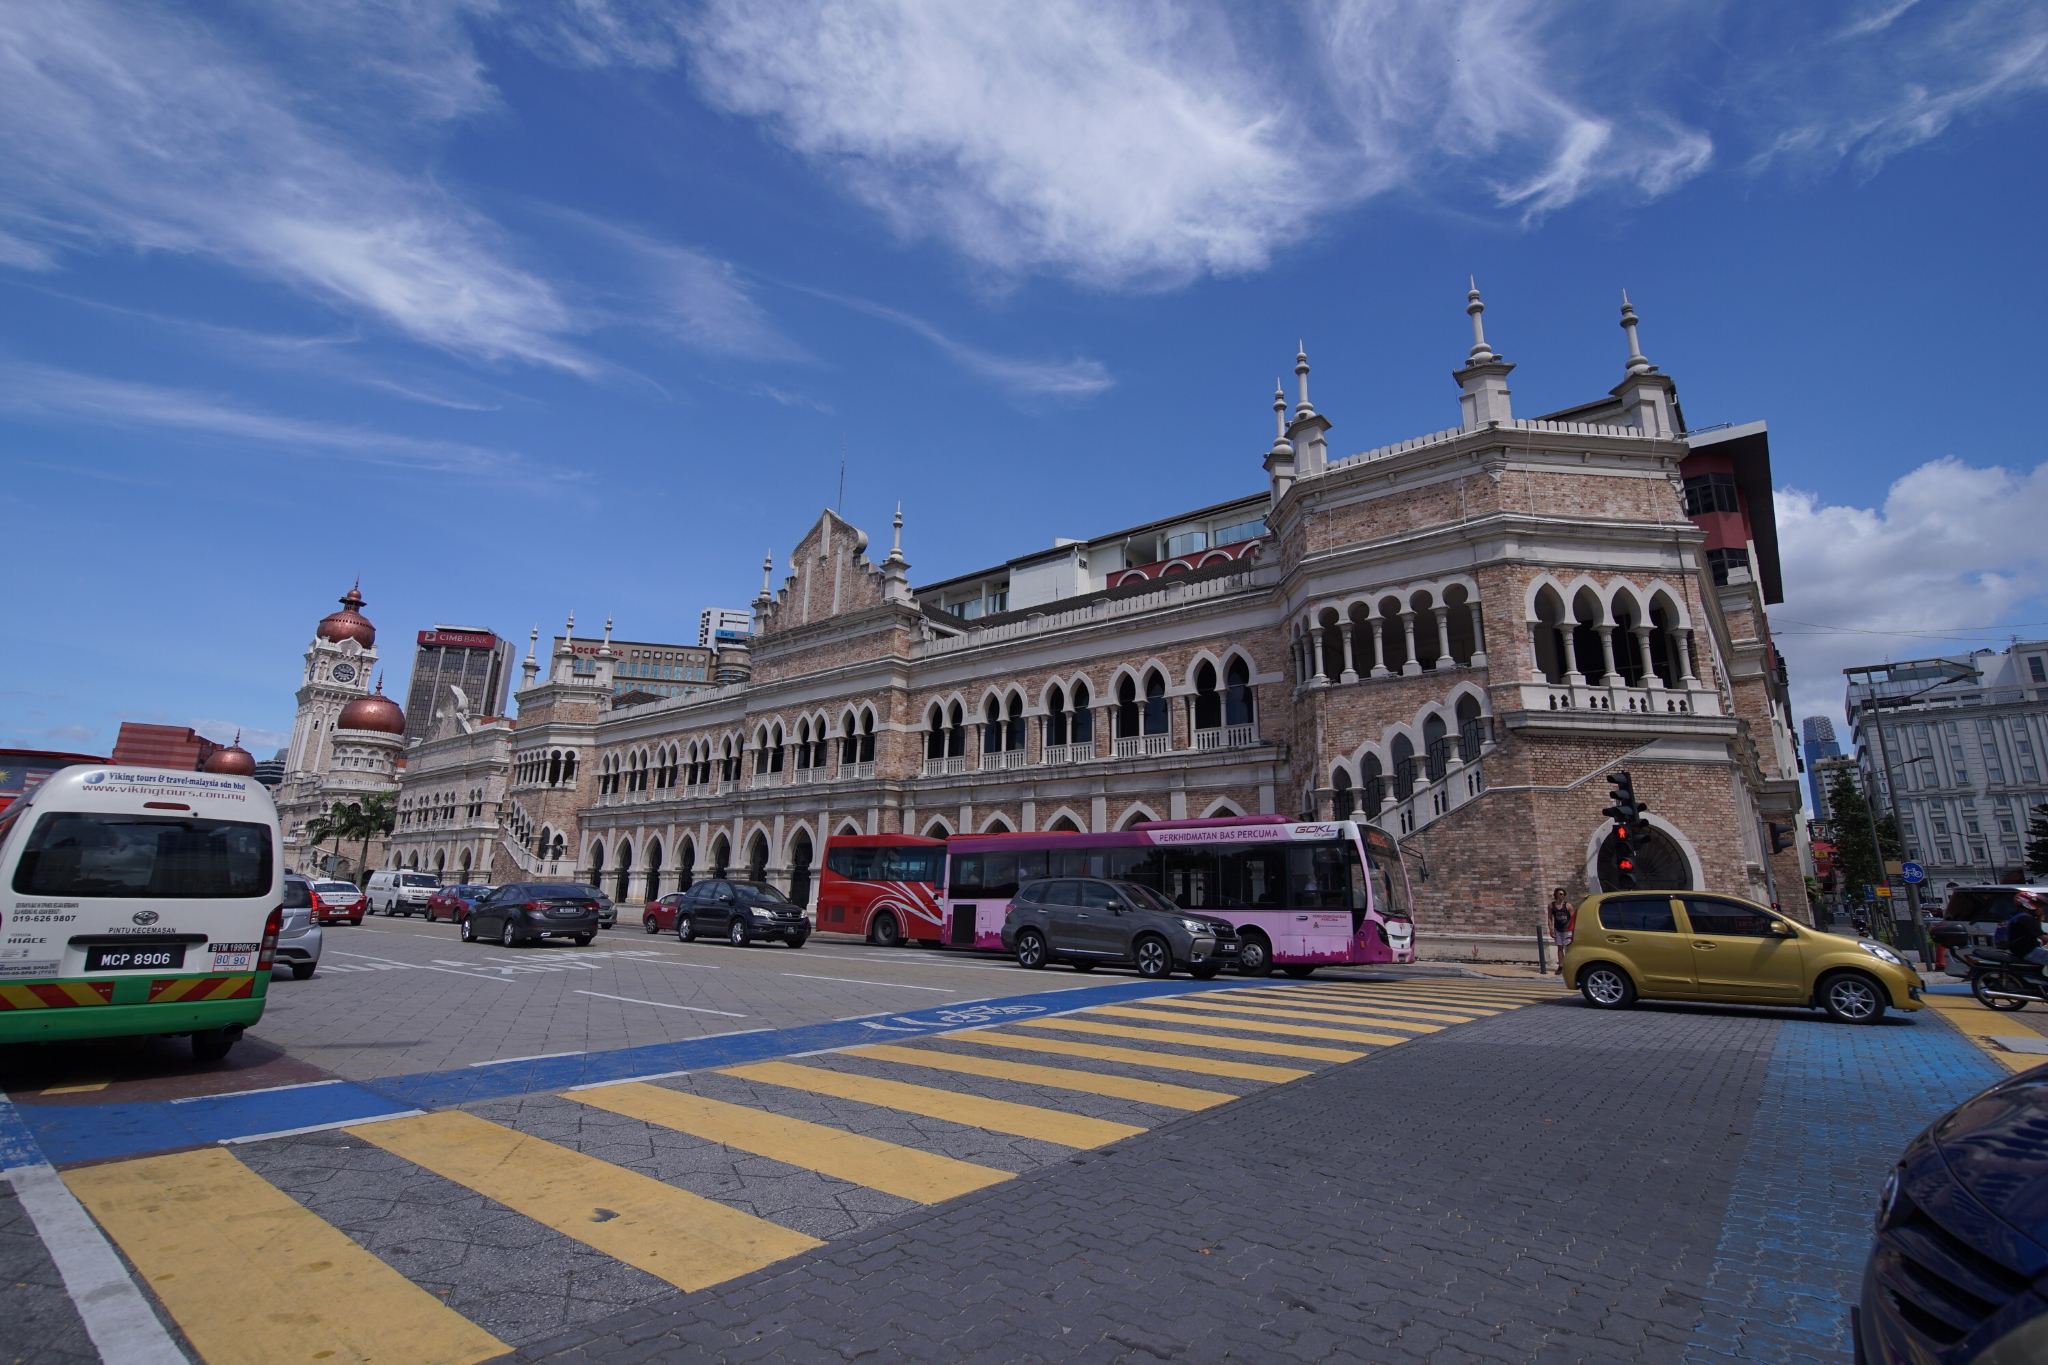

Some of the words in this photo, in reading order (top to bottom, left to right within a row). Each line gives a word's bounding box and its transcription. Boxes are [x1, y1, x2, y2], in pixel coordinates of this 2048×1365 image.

[464, 636, 487, 644] BANK
[109, 772, 134, 782] Viking
[137, 775, 157, 783] tours
[166, 776, 219, 788] travel-malaysia
[220, 781, 232, 789] sdn
[1296, 825, 1337, 834] GOKL
[1159, 832, 1217, 842] PERKHIDMATAN
[1220, 831, 1235, 839] BAS
[1237, 829, 1278, 839] PERCUMA
[211, 944, 228, 952] BTM
[101, 954, 130, 966] MCP
[133, 953, 171, 965] 8906
[216, 954, 229, 964] 80
[233, 956, 246, 965] 90
